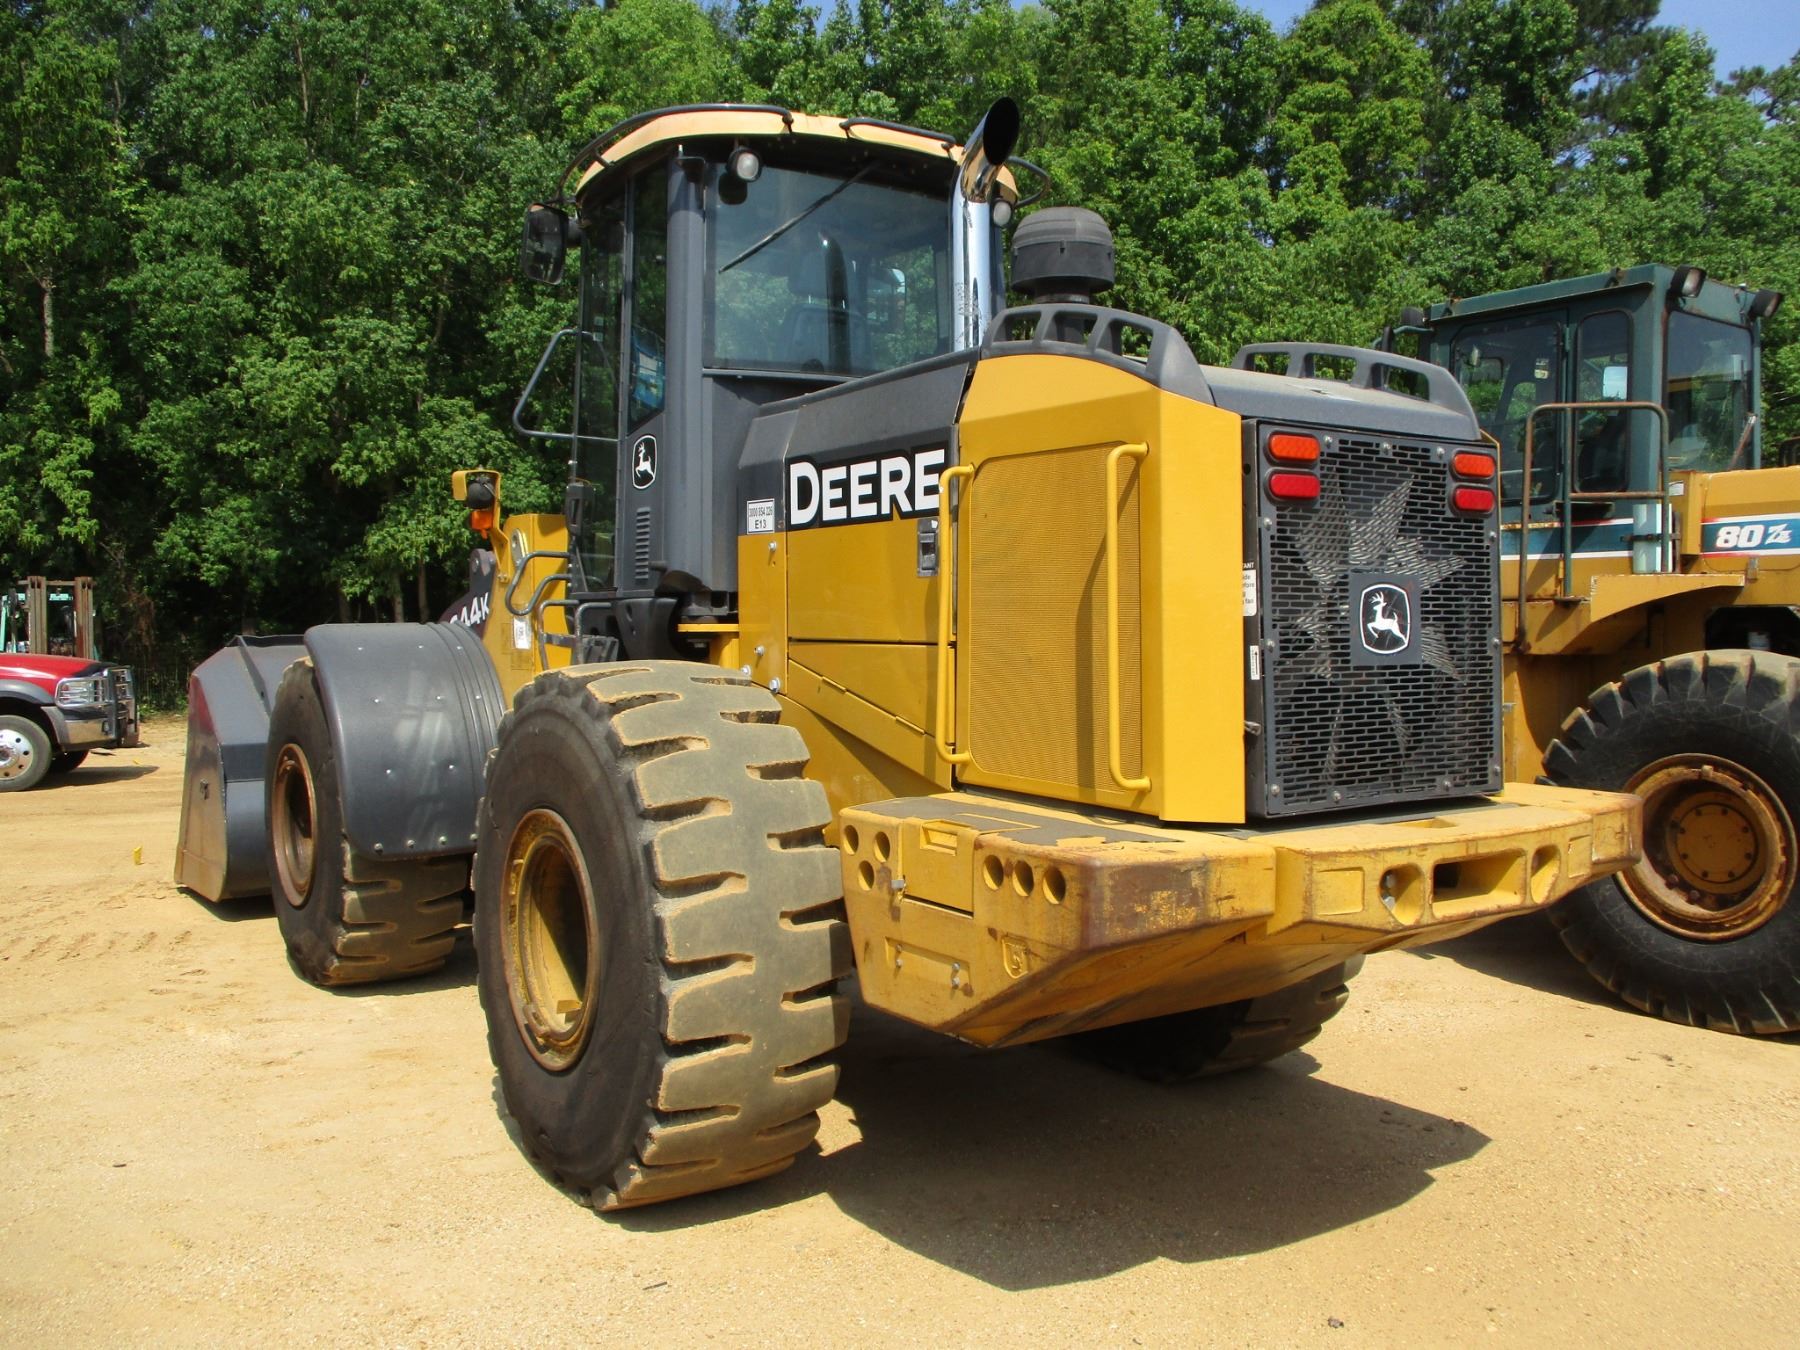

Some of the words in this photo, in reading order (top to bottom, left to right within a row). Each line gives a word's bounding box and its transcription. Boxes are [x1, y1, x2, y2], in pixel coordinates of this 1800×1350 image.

[790, 449, 945, 525] DEERE
[754, 519, 767, 529] E13
[1716, 524, 1765, 548] 80
